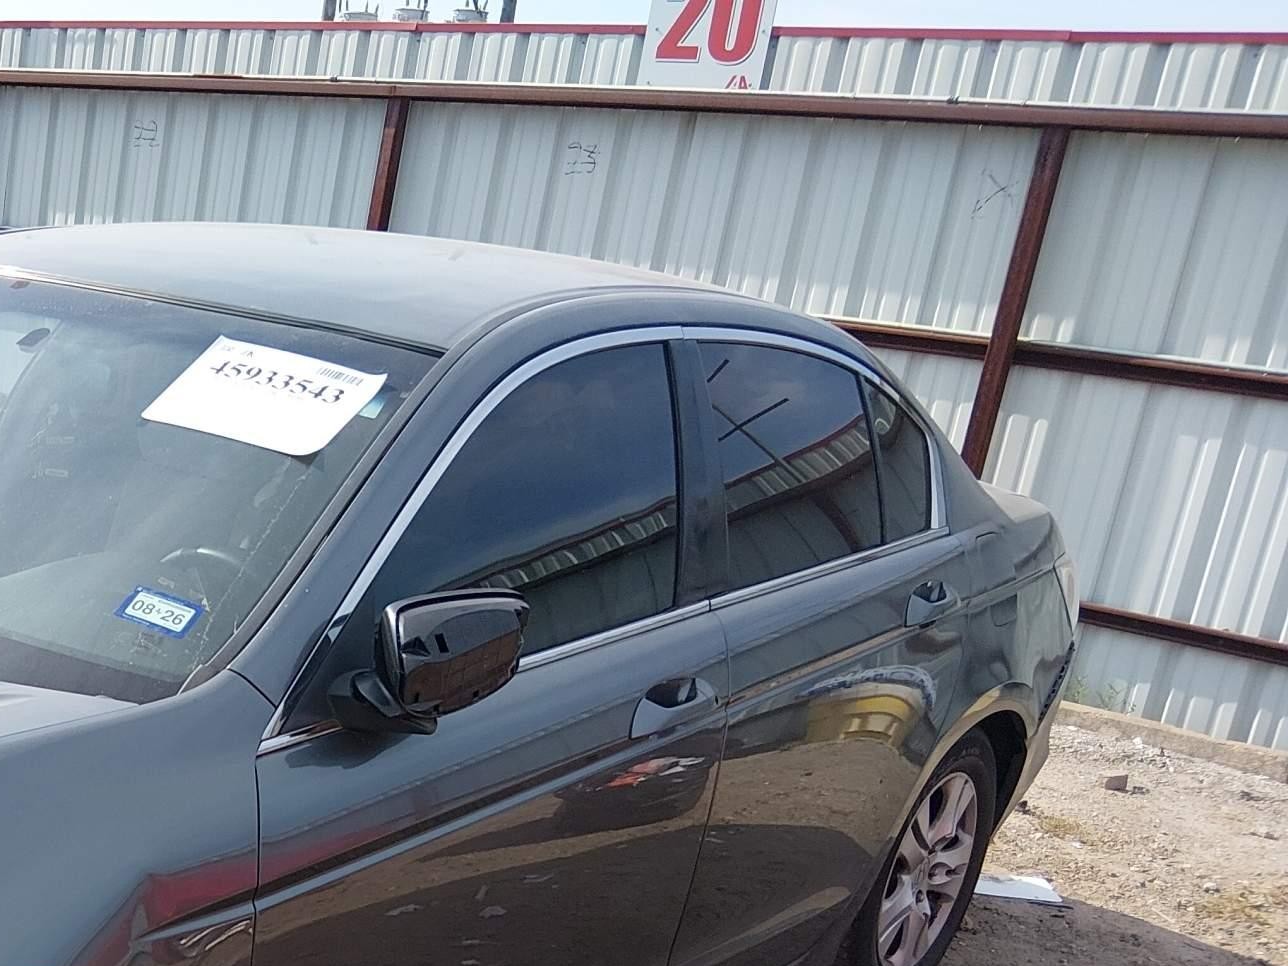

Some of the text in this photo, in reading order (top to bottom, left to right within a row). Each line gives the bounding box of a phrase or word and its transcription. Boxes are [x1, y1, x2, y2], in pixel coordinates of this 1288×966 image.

[655, 0, 765, 66] 20
[210, 361, 345, 403] 45933543
[132, 600, 185, 625] 08 26
